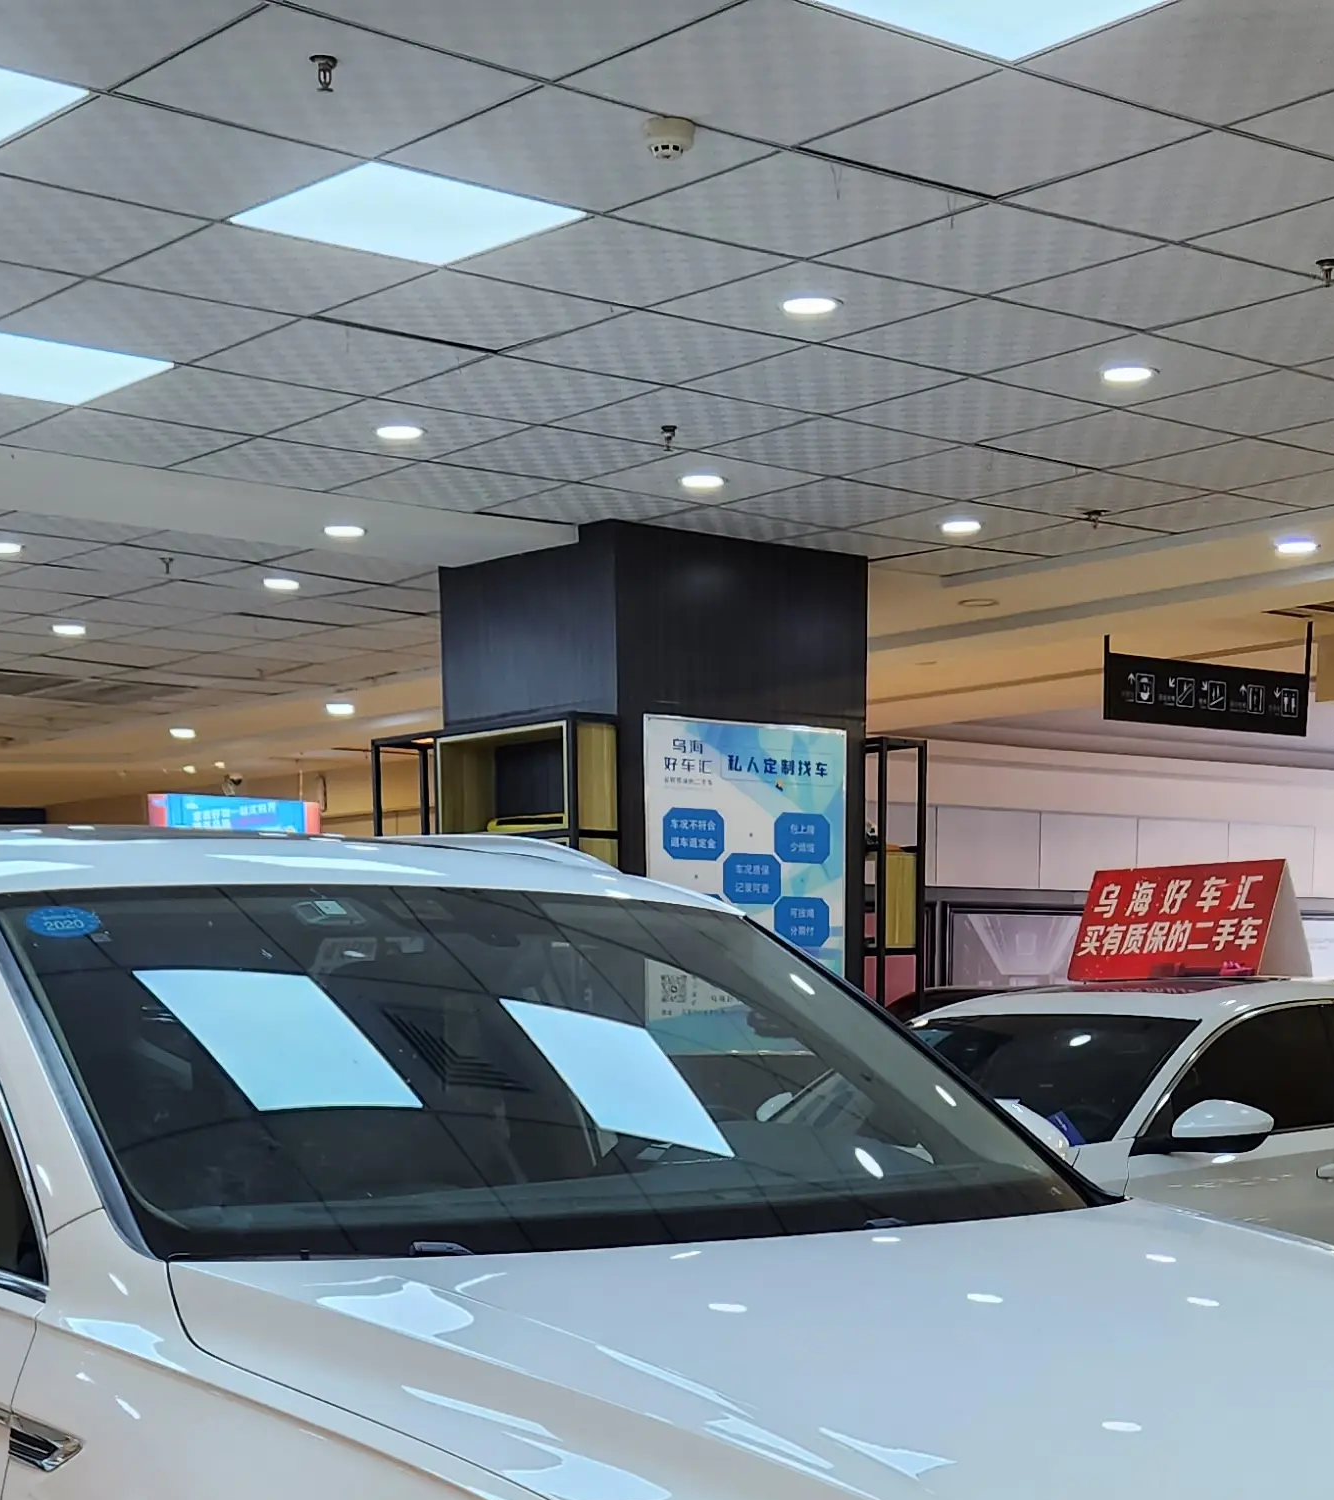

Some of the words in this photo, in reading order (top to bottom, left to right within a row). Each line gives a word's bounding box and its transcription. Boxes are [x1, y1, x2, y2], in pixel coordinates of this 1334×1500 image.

[672, 738, 704, 754] 乌海
[664, 757, 713, 774] 好车汇
[728, 754, 829, 778] 私人定制找车
[1093, 875, 1264, 919] 乌海好车汇
[43, 919, 84, 930] 2020
[1076, 916, 1263, 957] 买有质保的二手车
